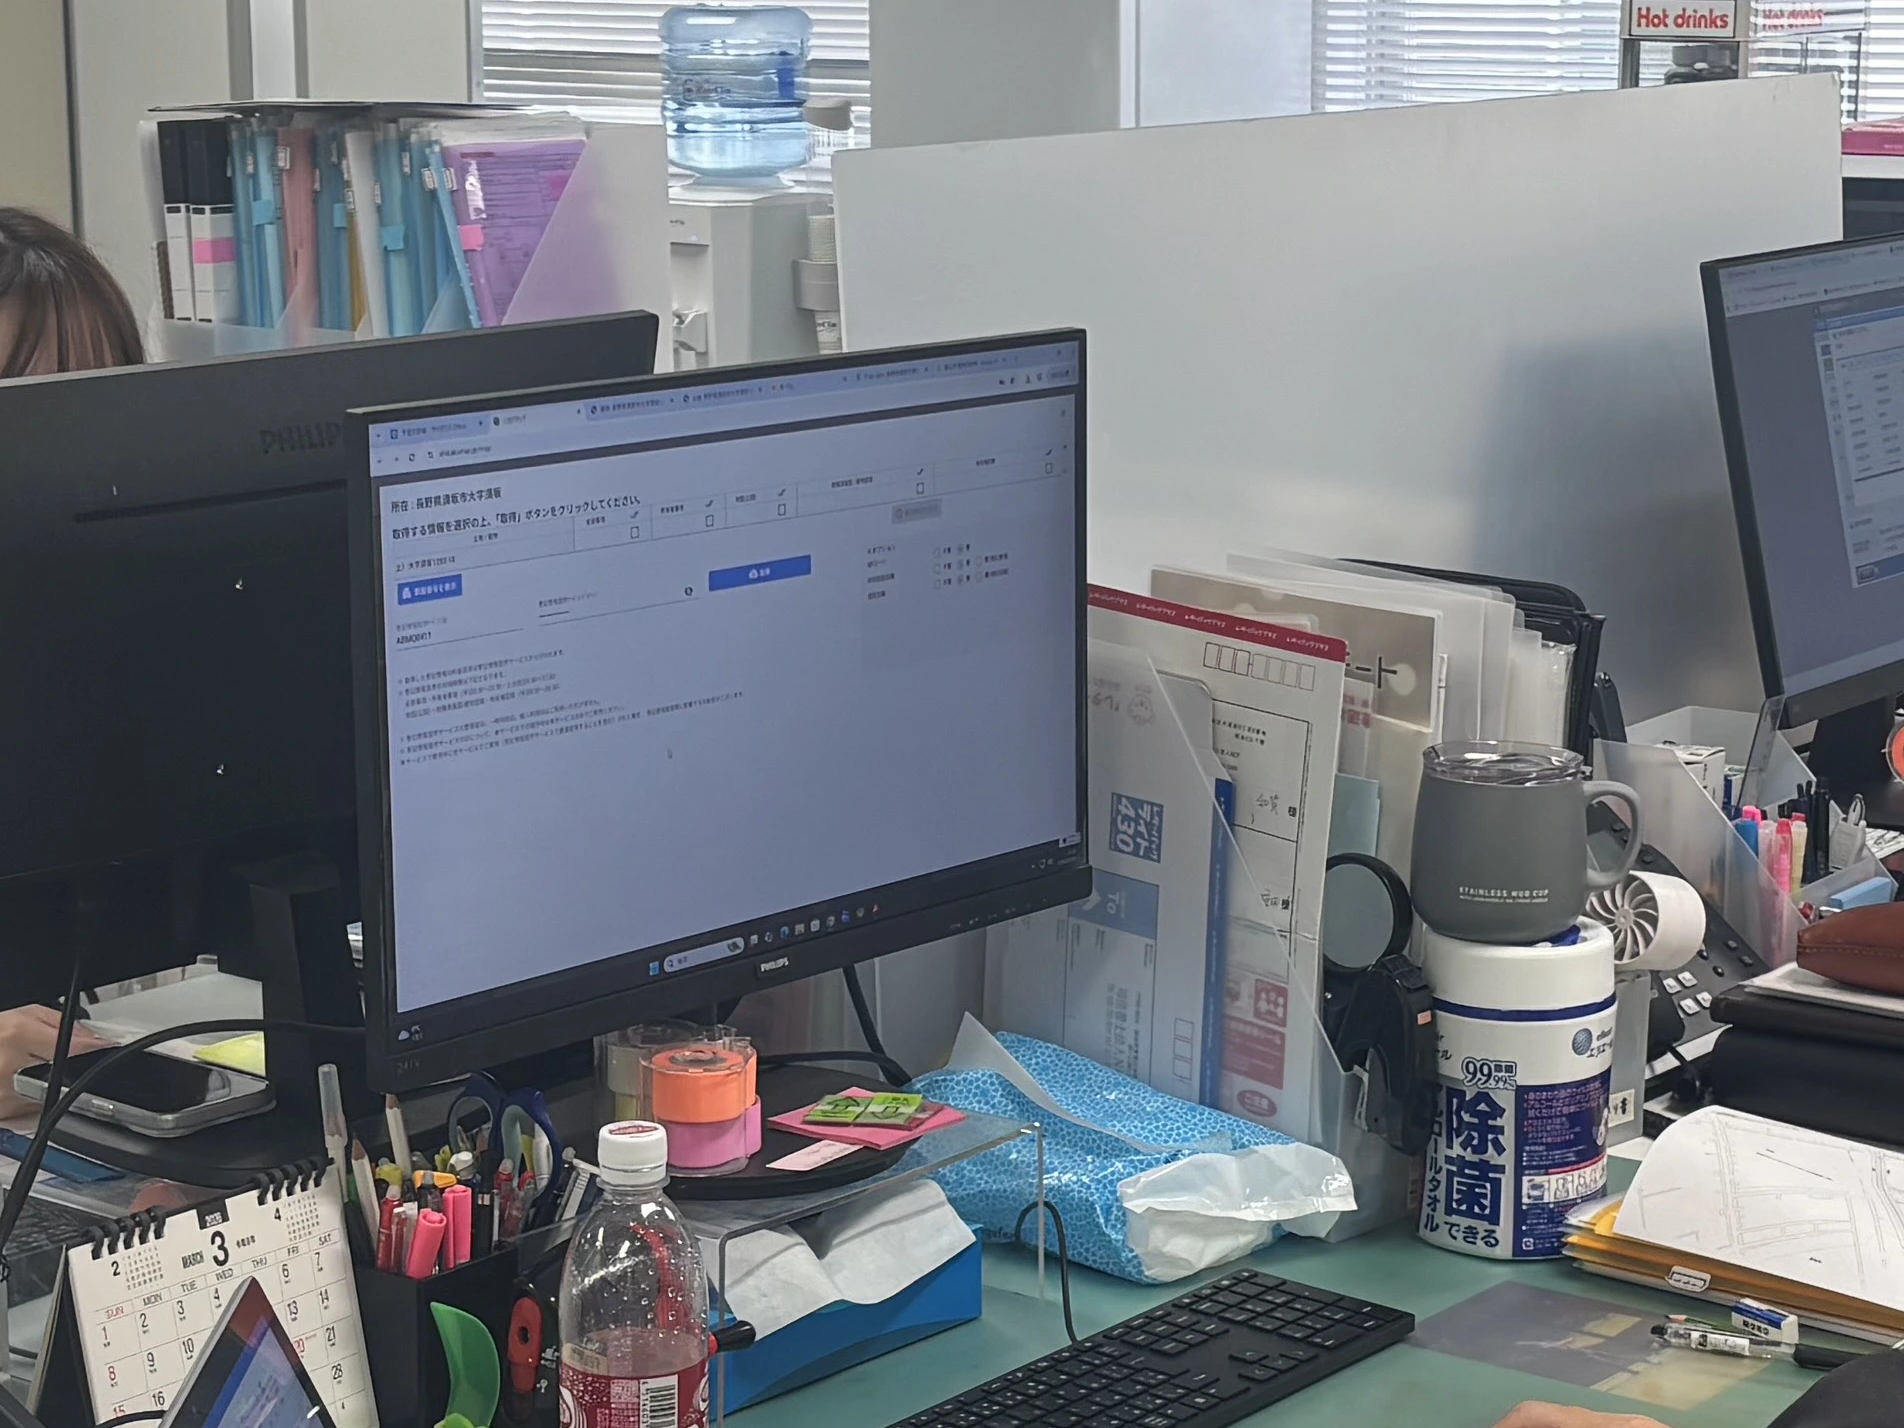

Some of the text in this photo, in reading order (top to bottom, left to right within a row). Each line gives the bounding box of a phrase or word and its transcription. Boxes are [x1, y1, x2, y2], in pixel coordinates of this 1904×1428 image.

[1636, 6, 1729, 29] Hot drinks
[1116, 796, 1136, 853] 430
[1136, 802, 1151, 856] ライト
[1106, 891, 1120, 915] To
[1459, 886, 1508, 897] STAINLESS
[1532, 888, 1549, 897] CUP
[1444, 1085, 1507, 1227] 除菌
[273, 1207, 282, 1222] 4
[181, 1230, 230, 1270] MARCH 3
[1444, 1221, 1500, 1249] できる
[110, 1260, 120, 1277] 2
[142, 1292, 163, 1307] MON
[181, 1279, 198, 1294] TUE
[216, 1268, 234, 1282] WED
[251, 1256, 268, 1269] THU
[287, 1244, 300, 1257] FRI
[318, 1234, 332, 1247] SAT
[102, 1251, 322, 1341] 1 2 3 4 6 7
[107, 1289, 330, 1382] 8 9 10 13 14
[152, 1391, 166, 1406] 16
[325, 1326, 337, 1342] 21
[331, 1363, 344, 1380] 28
